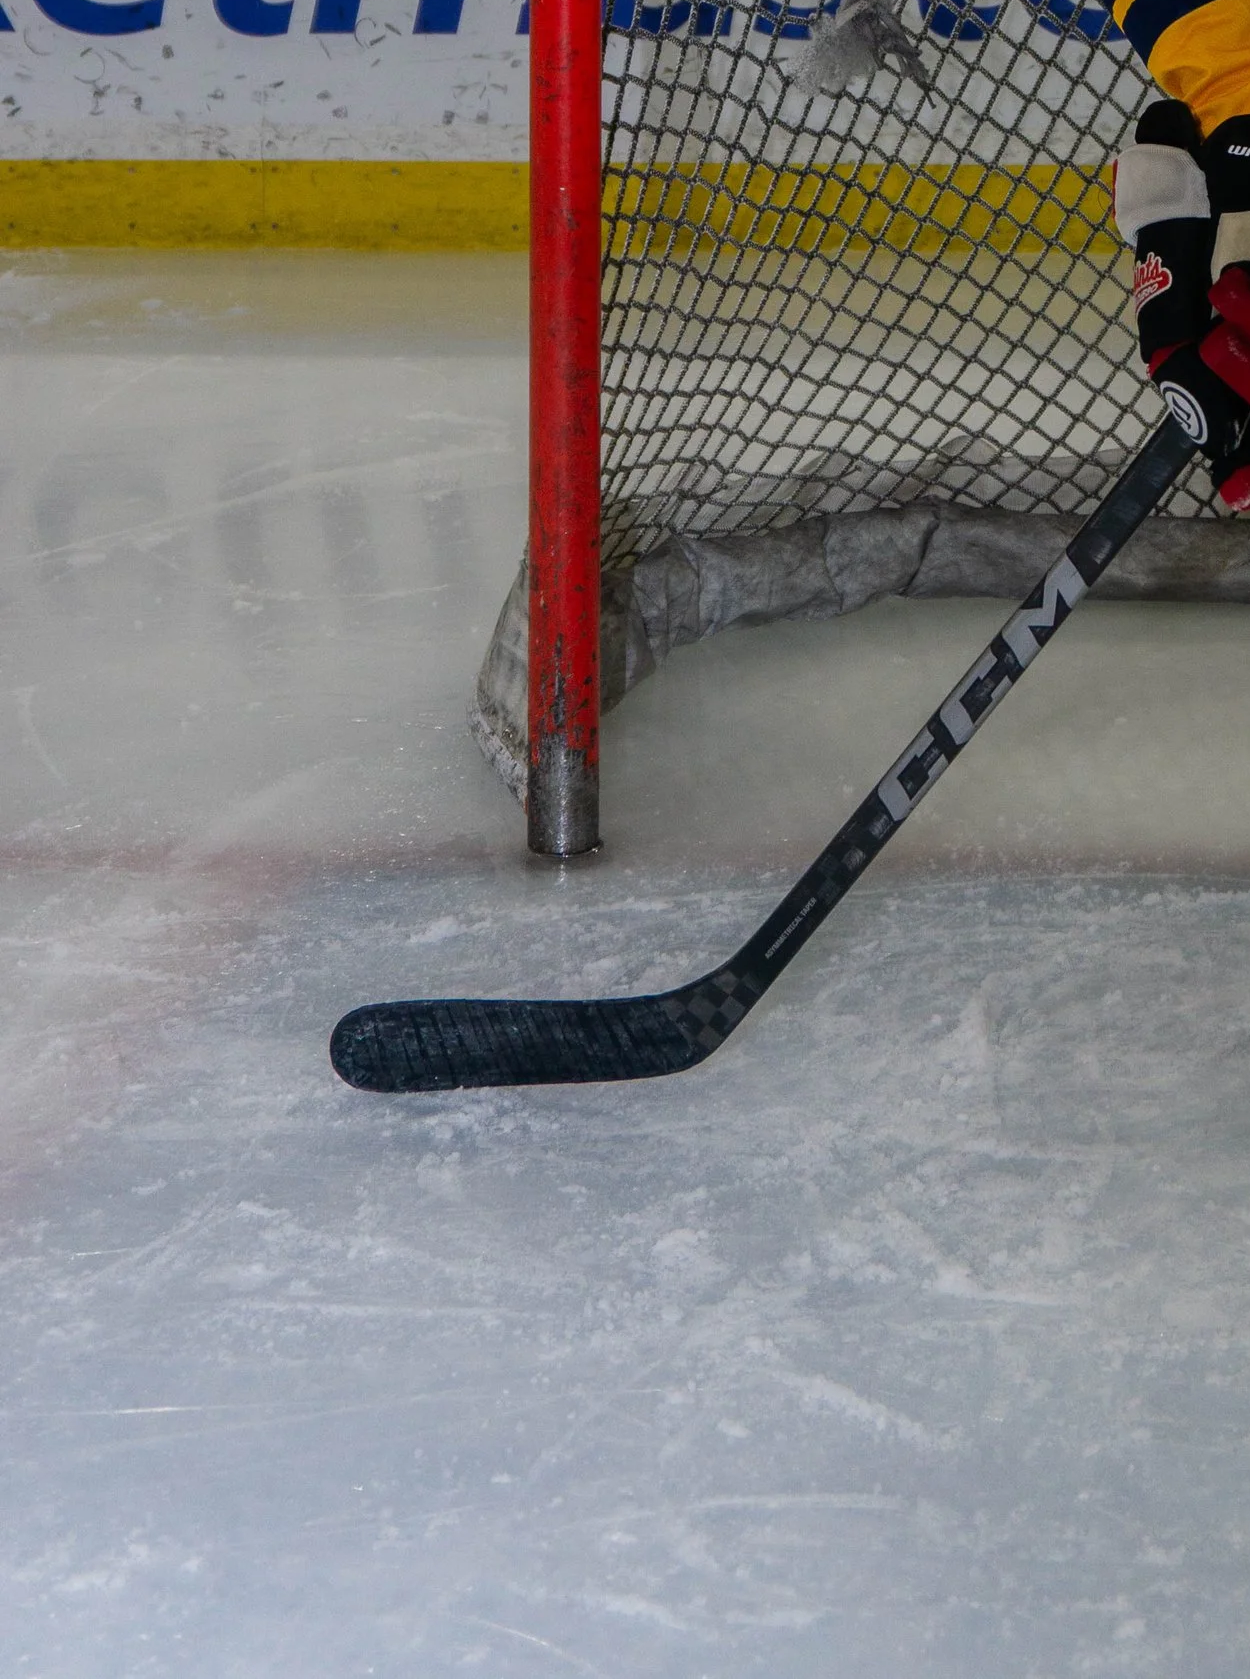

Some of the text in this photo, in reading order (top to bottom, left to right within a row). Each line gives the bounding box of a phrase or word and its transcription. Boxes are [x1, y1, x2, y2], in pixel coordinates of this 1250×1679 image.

[878, 556, 1090, 821] CCM
[765, 896, 817, 960] ASYMMETRICAL TAPER
